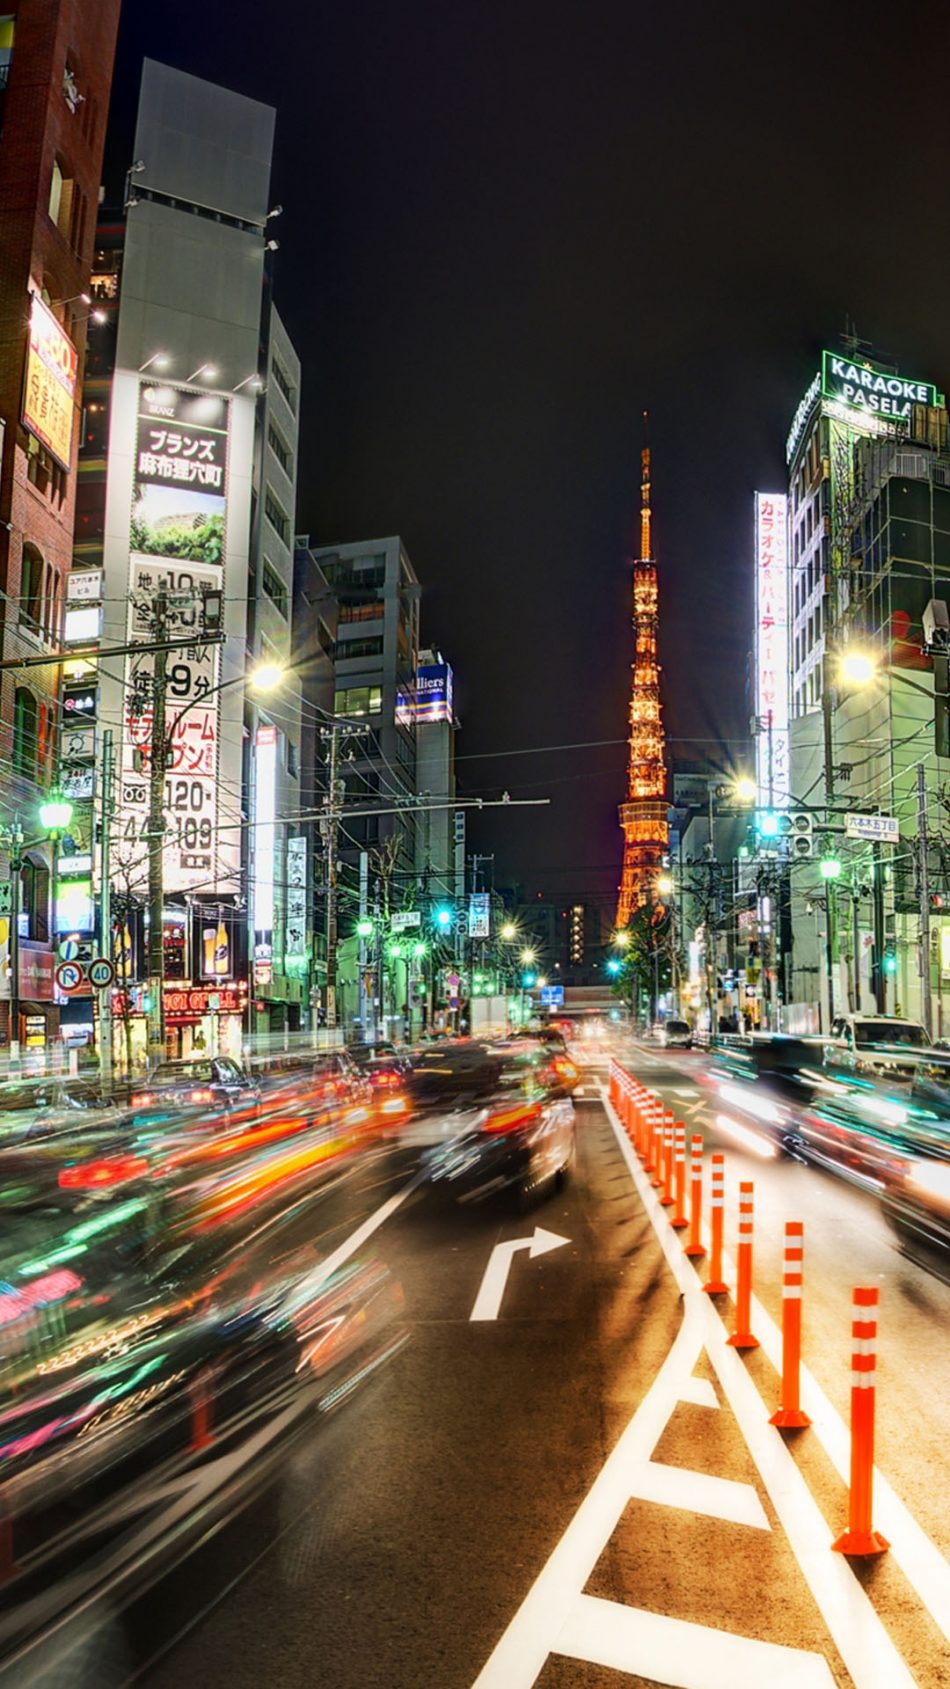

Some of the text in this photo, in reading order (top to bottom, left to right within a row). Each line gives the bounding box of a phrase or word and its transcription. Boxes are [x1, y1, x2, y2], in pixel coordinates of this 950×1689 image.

[831, 357, 928, 402] KARAOKE
[843, 383, 912, 418] PASELA
[150, 430, 216, 461] ブランズ
[138, 452, 222, 487] 麻布狸穴町
[94, 966, 109, 980] 40
